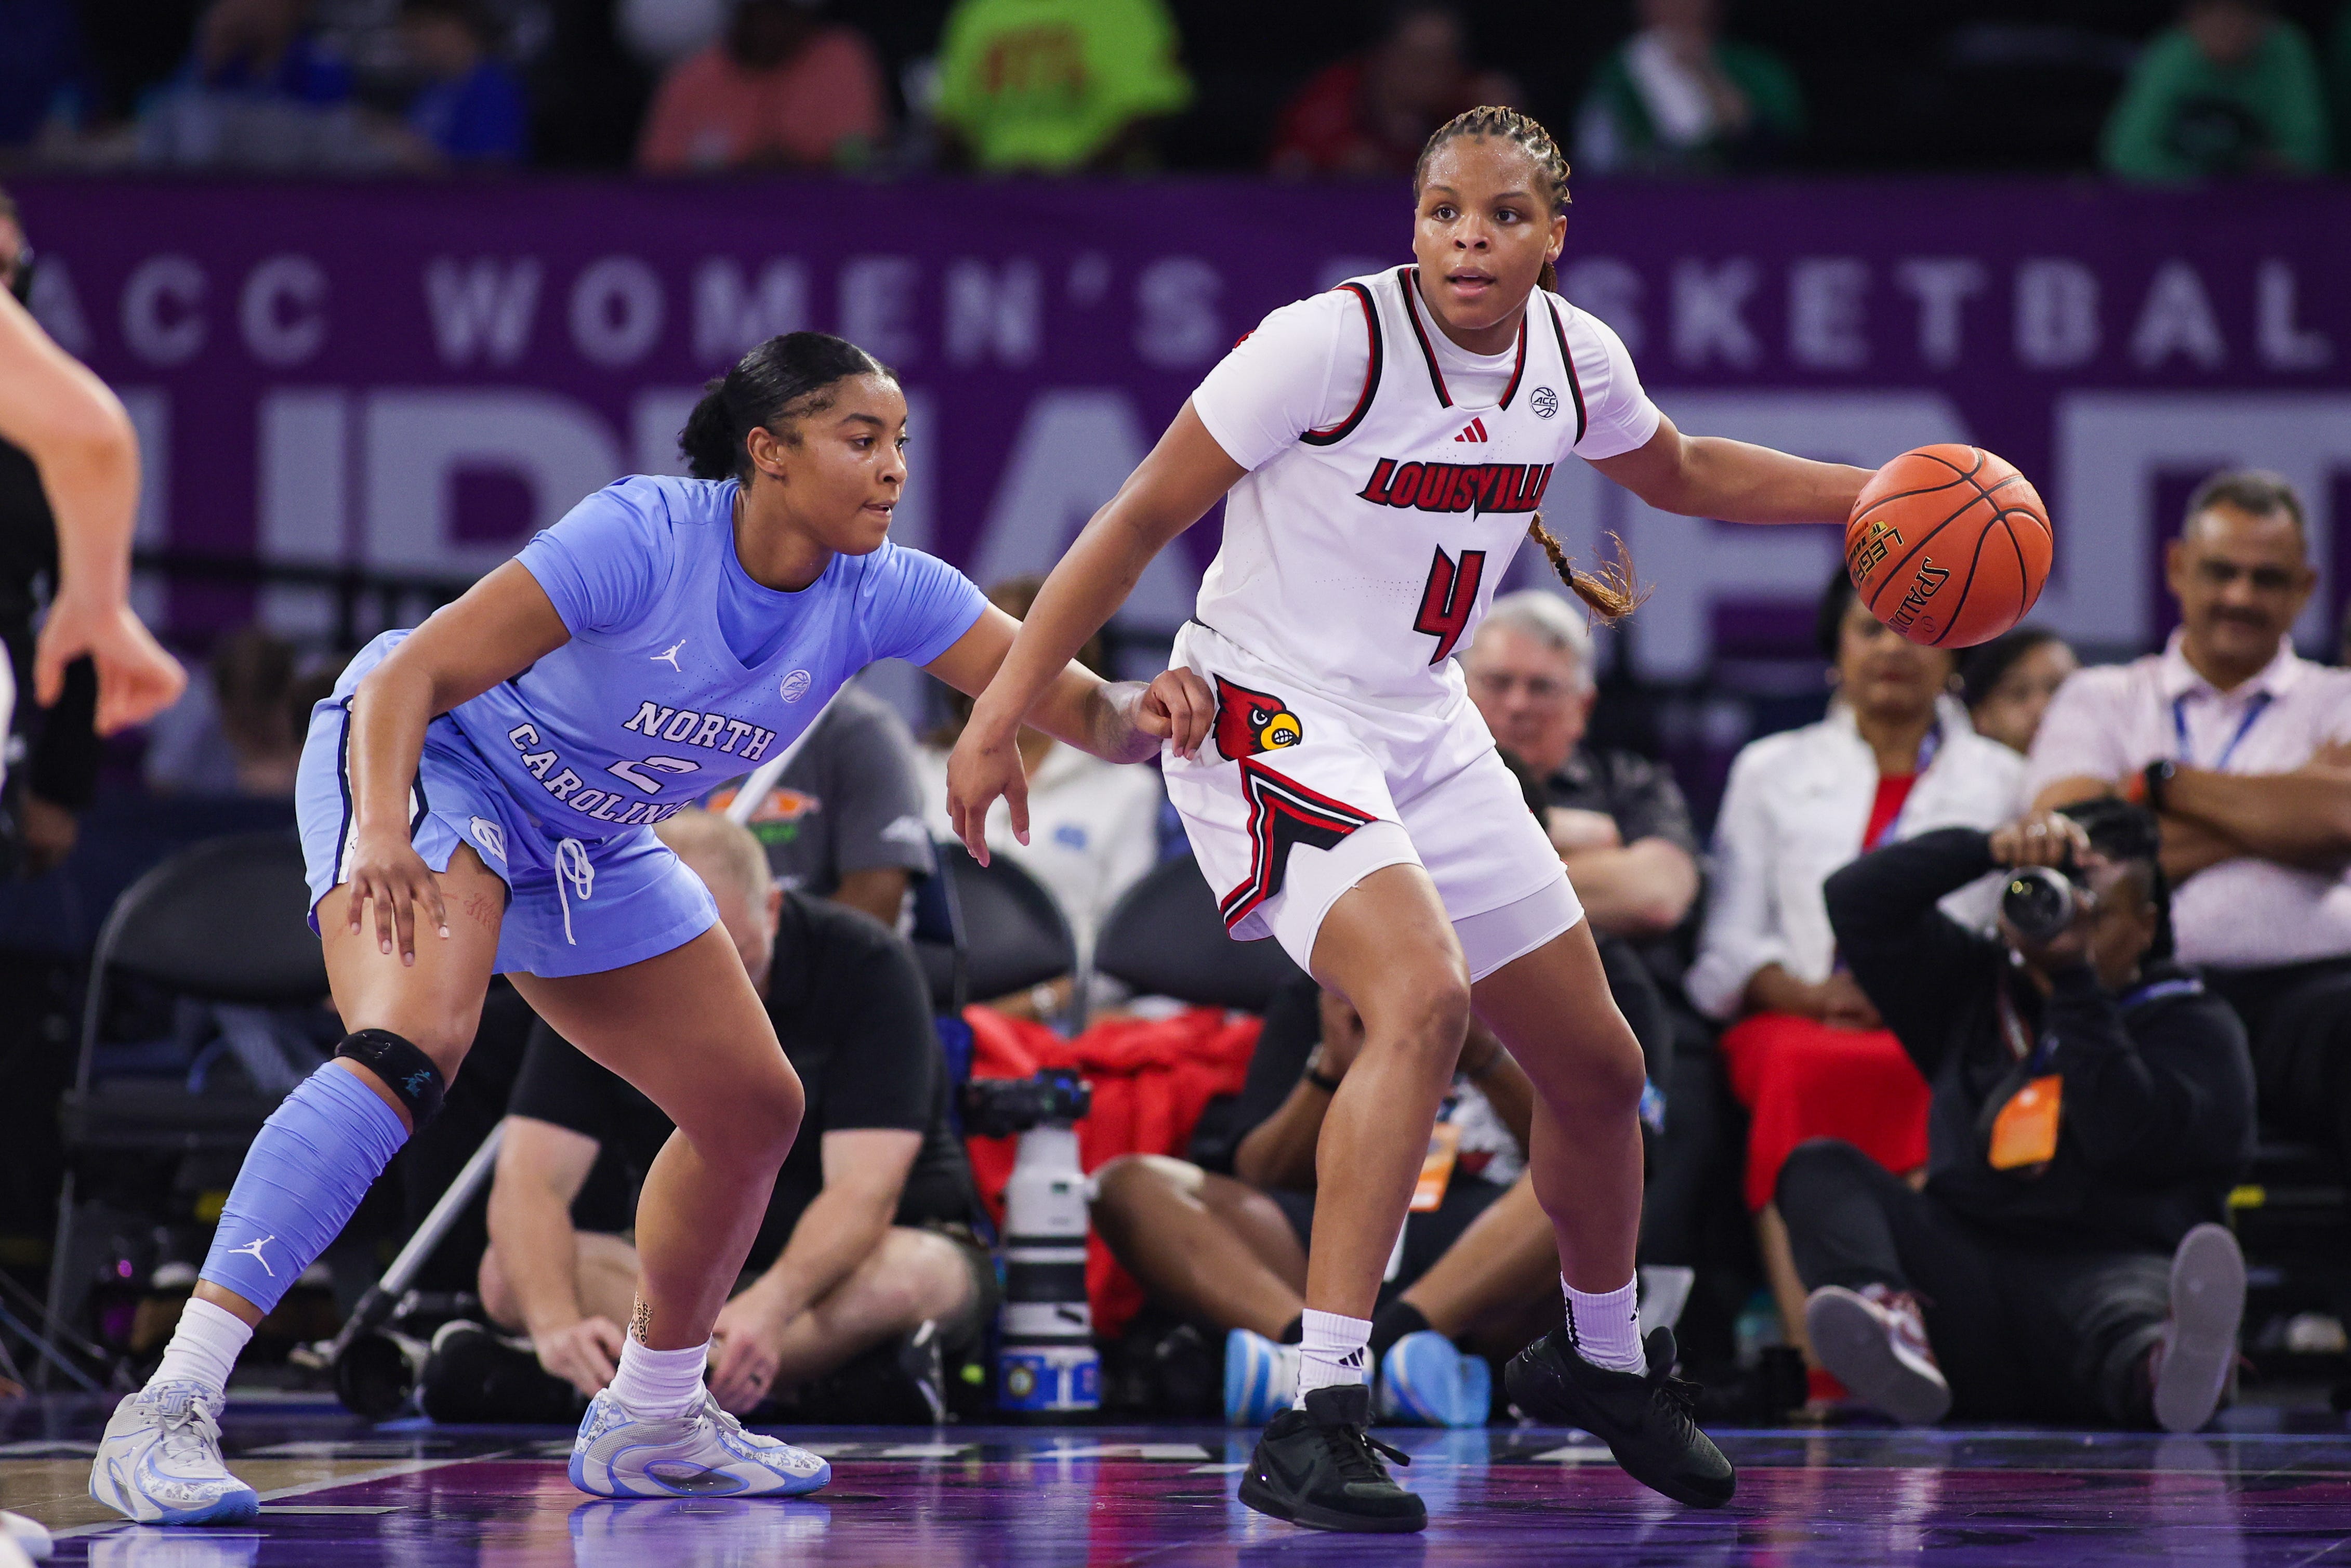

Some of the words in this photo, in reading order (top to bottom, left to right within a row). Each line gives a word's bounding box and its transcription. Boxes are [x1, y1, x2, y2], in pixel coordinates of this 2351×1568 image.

[422, 251, 1221, 370] WOMEN'S
[1534, 397, 1557, 405] ACC
[1412, 543, 1487, 667] 4
[622, 700, 777, 762] NORTH
